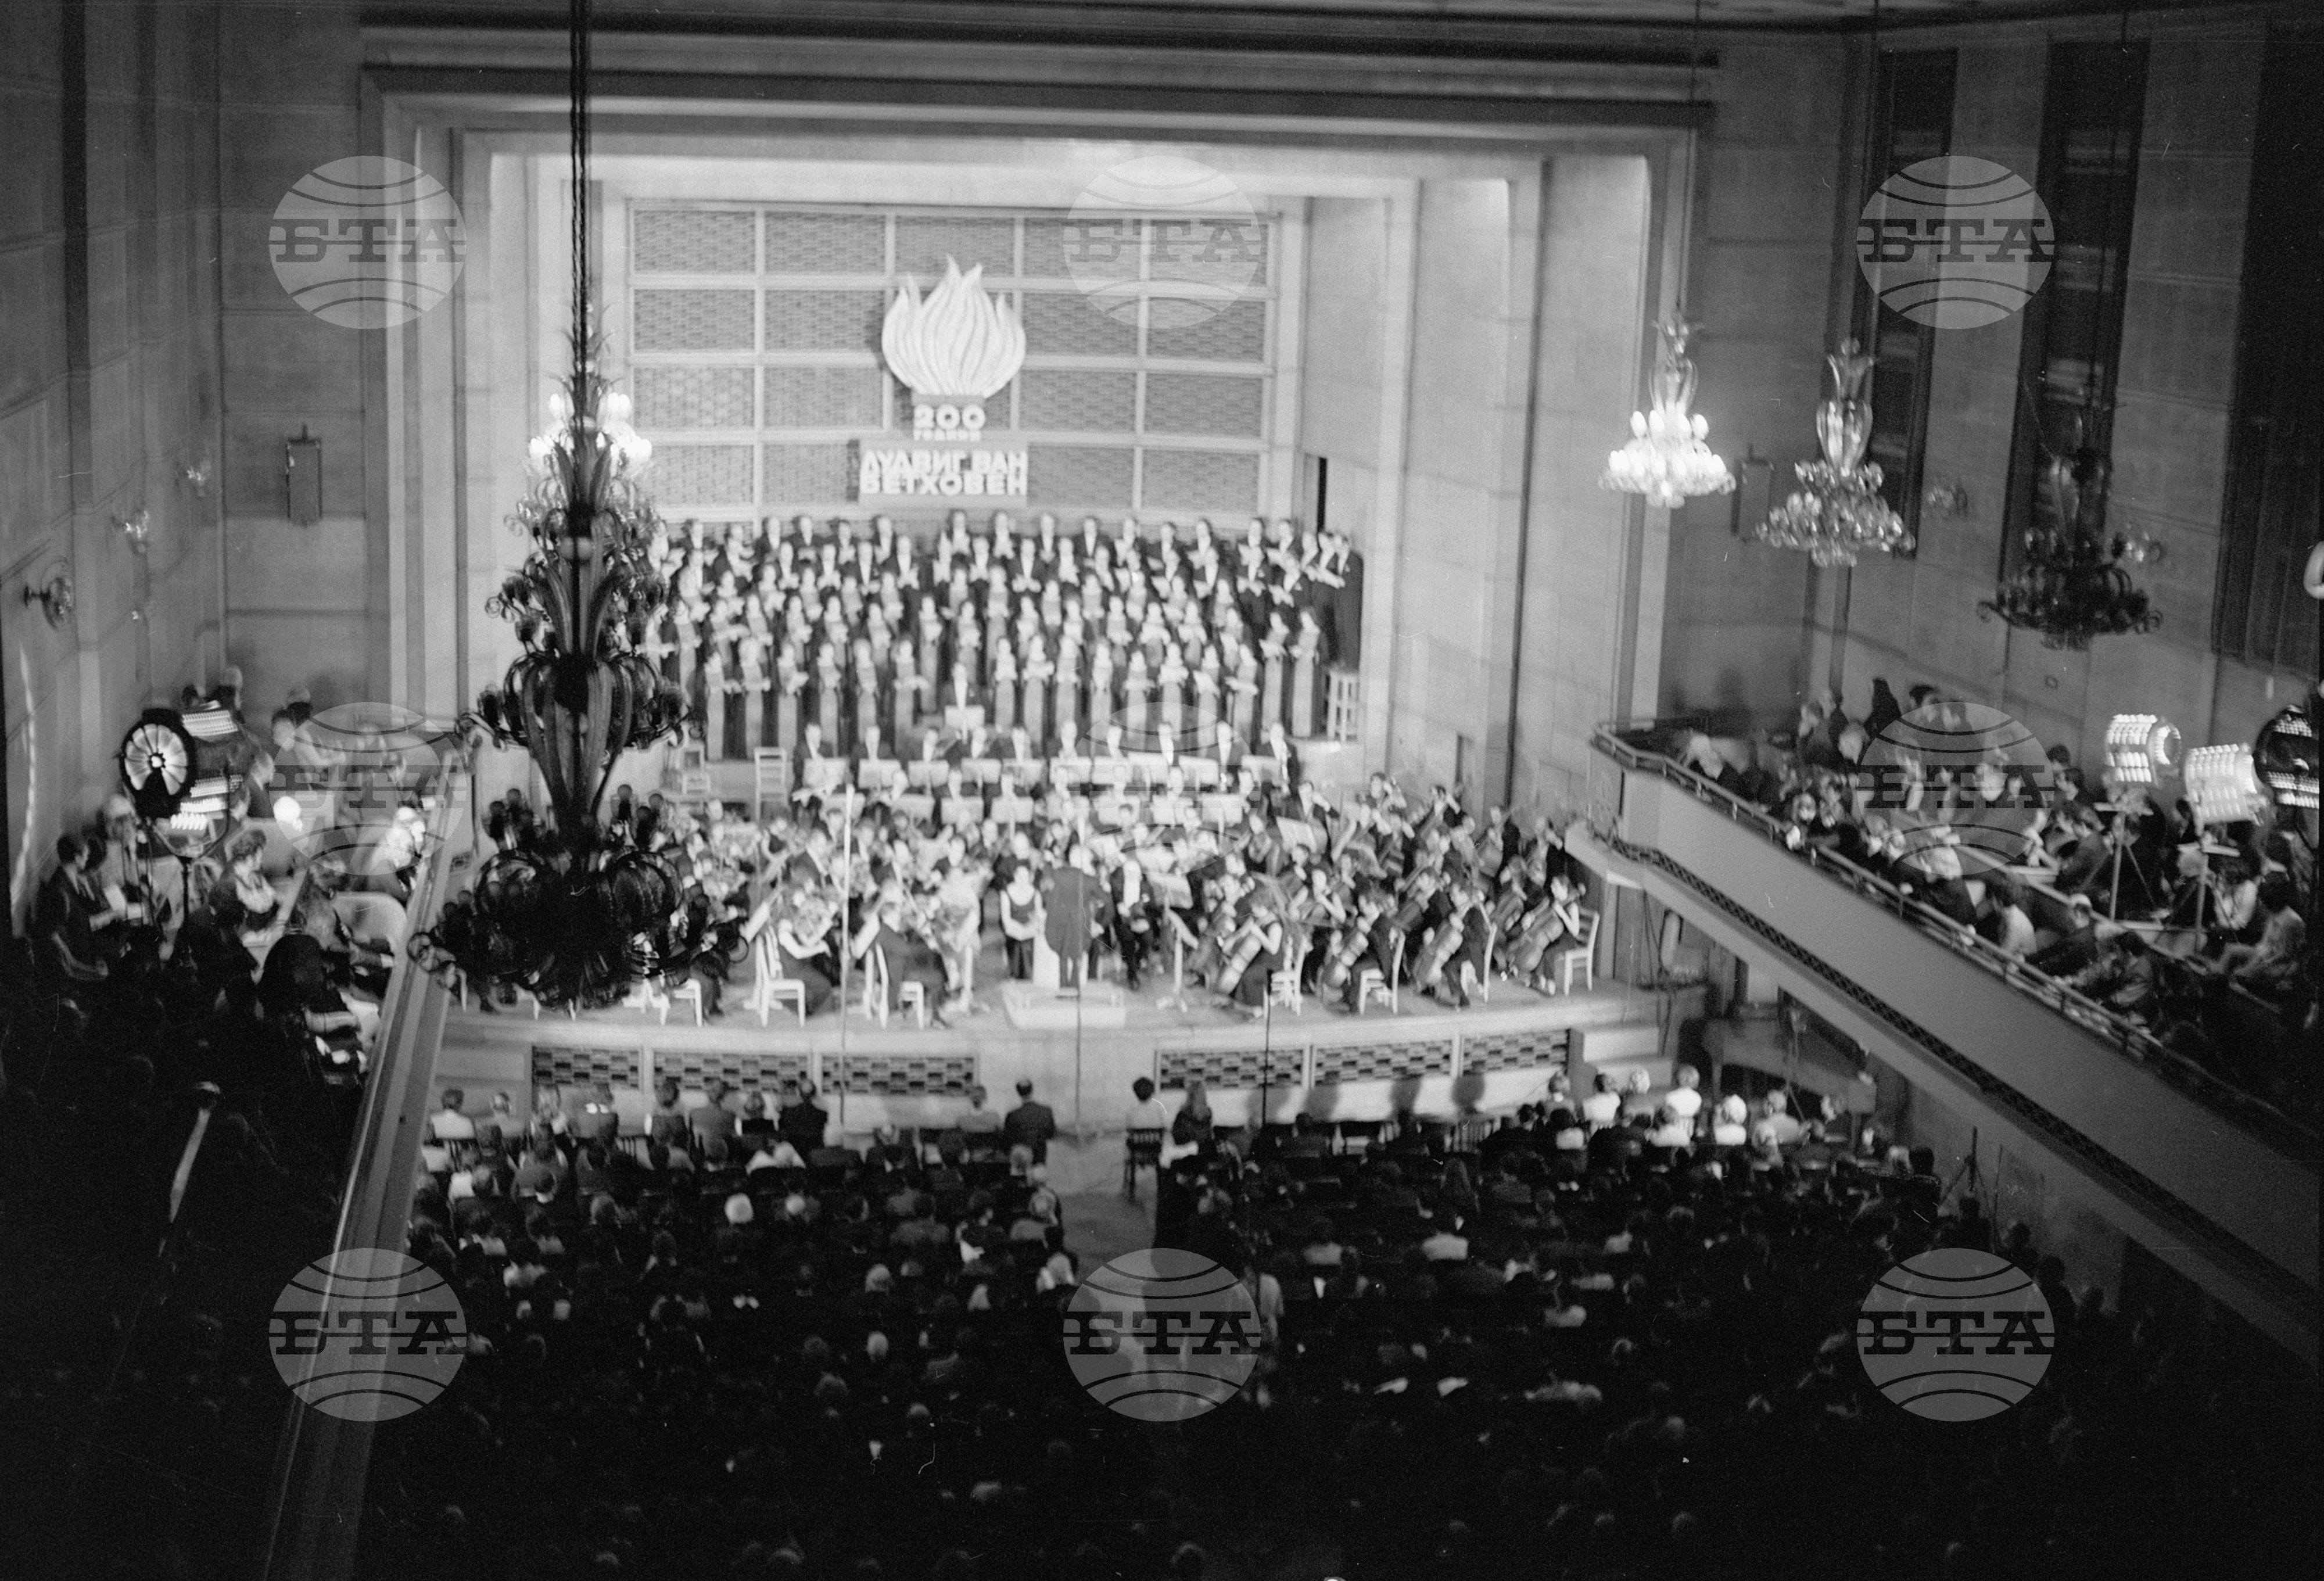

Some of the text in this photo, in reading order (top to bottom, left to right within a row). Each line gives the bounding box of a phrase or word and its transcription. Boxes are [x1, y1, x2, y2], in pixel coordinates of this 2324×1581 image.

[913, 404, 986, 429] 200
[971, 449, 1028, 474] ВАН
[860, 472, 1028, 495] ВЕТХОВЕН
